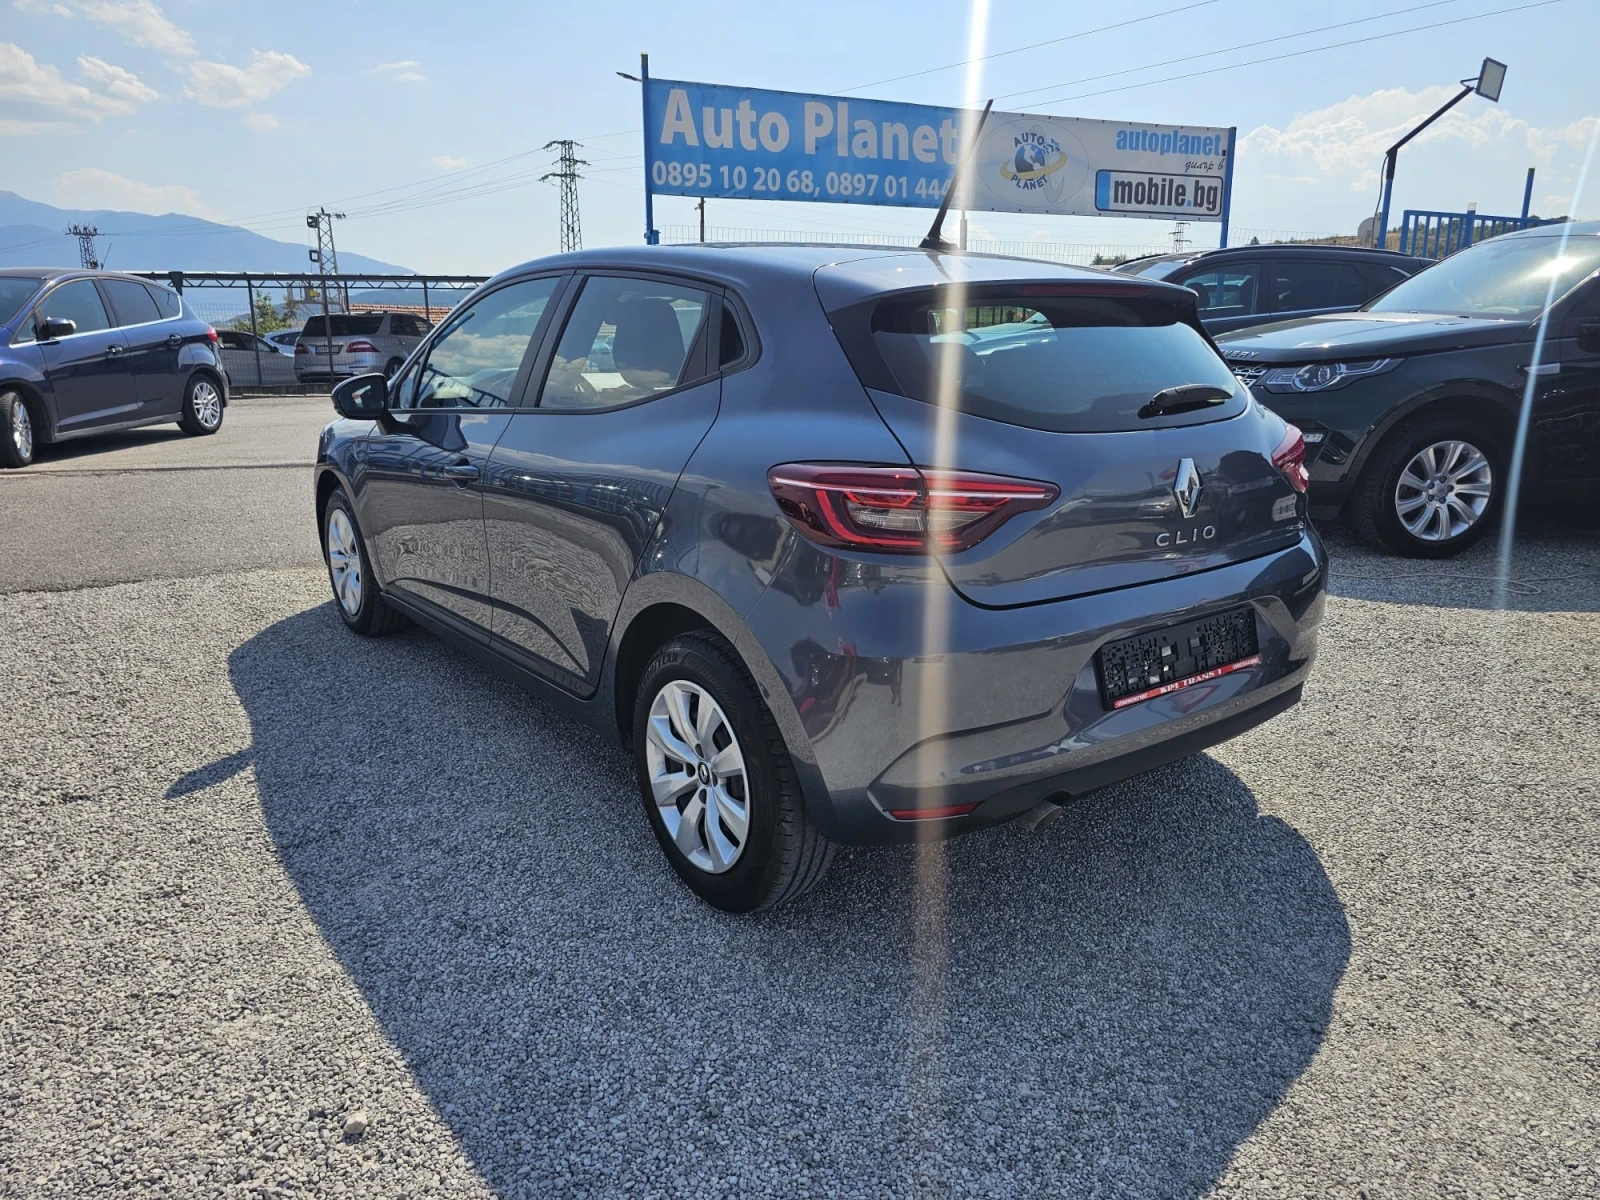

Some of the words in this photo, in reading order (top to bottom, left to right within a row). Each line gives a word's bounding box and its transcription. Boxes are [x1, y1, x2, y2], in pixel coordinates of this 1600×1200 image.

[660, 89, 789, 152] Auto
[804, 101, 957, 165] Planet
[1014, 132, 1045, 148] AUTO
[652, 160, 712, 188] 0895
[719, 165, 747, 190] 10
[753, 167, 781, 192] 20
[786, 169, 820, 197] 68,
[826, 171, 879, 197] 0897
[885, 175, 907, 198] 01
[1011, 174, 1048, 190] PLANET
[1113, 177, 1219, 212] mobile.bg
[1156, 525, 1216, 547] CLIO
[1159, 682, 1179, 694] KIM
[1182, 671, 1215, 686] TRANS
